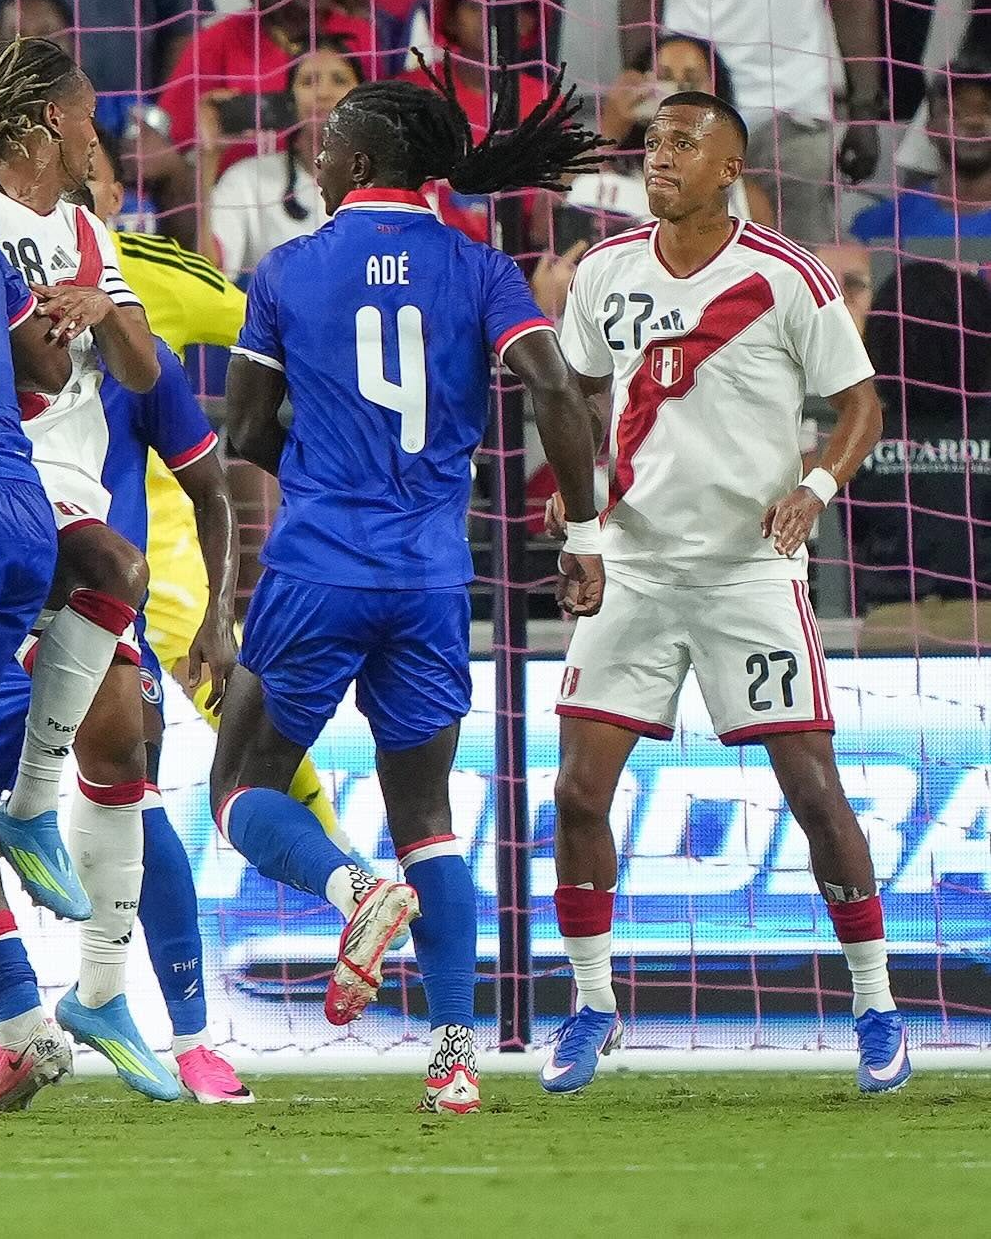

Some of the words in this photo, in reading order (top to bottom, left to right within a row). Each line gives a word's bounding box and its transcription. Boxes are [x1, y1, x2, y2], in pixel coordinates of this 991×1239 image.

[366, 251, 411, 286] ADÉ
[603, 292, 654, 351] 27
[355, 304, 427, 454] 4
[745, 649, 799, 712] 27
[172, 957, 200, 973] FHF
